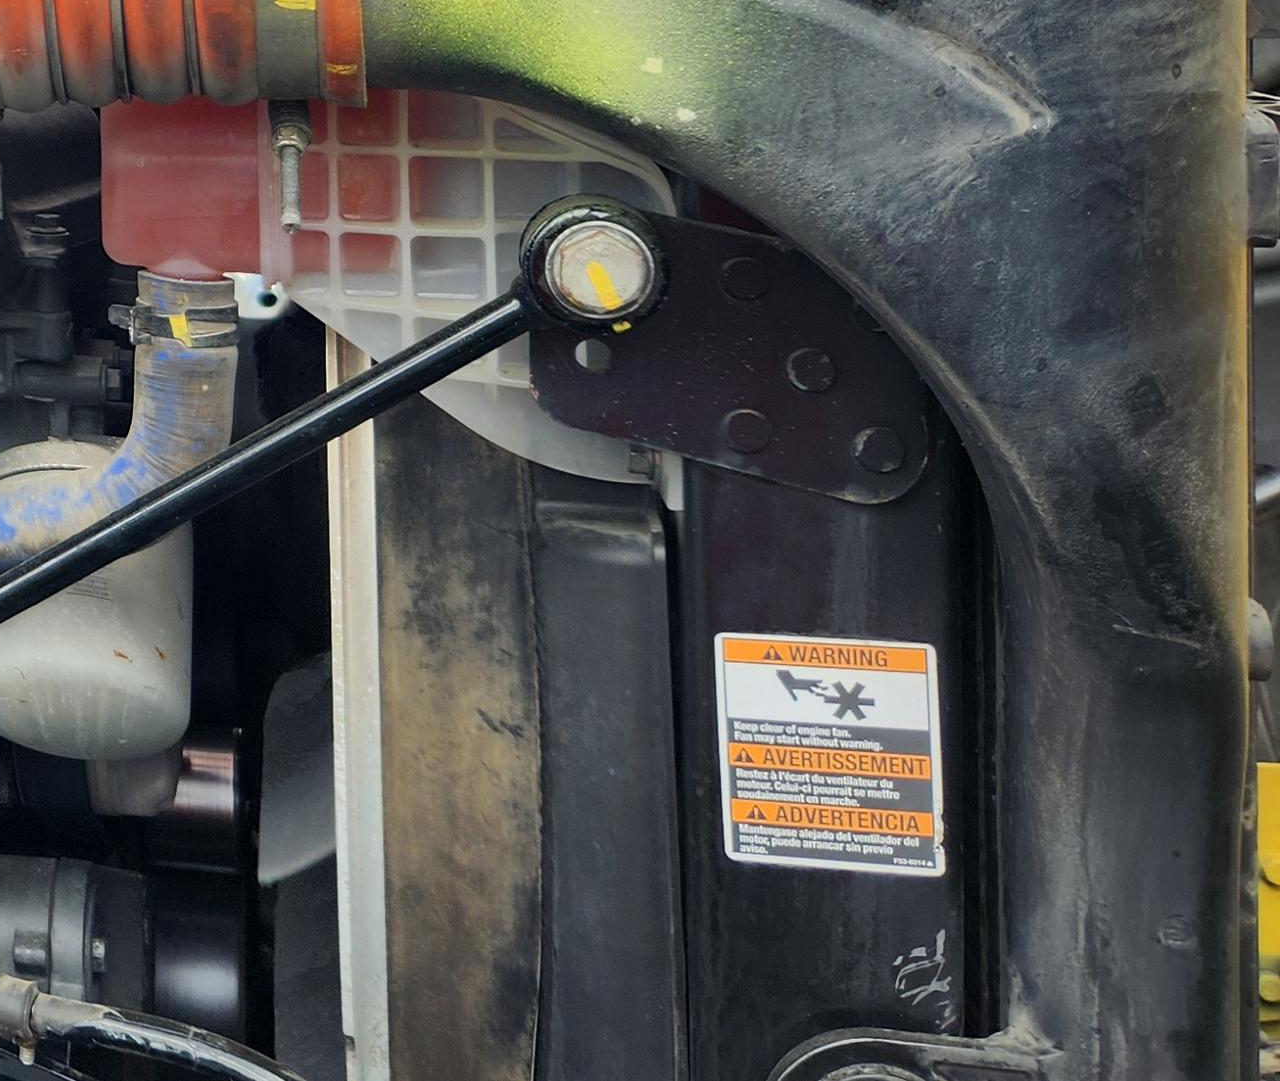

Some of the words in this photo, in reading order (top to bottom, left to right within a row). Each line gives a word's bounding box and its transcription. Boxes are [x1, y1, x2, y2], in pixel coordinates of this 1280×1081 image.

[788, 644, 888, 668] WARNING
[733, 720, 758, 733] Keep
[760, 722, 785, 734] clear
[785, 724, 797, 735] of
[797, 725, 831, 737] engine
[832, 727, 851, 738] fan.
[734, 730, 753, 742] Fan
[754, 733, 776, 745] may
[776, 734, 801, 745] start
[801, 735, 839, 748] without
[839, 739, 883, 752] warning.
[762, 748, 927, 776] AVERTISSEMENT
[735, 767, 769, 780] Restez
[811, 773, 825, 785] du
[825, 775, 878, 788] ventilateur
[879, 778, 894, 789] du
[736, 789, 805, 803] soudainement
[806, 795, 819, 804] en
[820, 796, 860, 807] marche.
[774, 781, 812, 794] Celui-ci
[812, 785, 853, 798] pourrait
[853, 788, 866, 797] se
[867, 789, 900, 800] mettre
[775, 805, 920, 833] ADVERTENCIA
[738, 823, 797, 837] Mantengase
[799, 829, 834, 841] alejado
[835, 831, 852, 841] del
[853, 833, 902, 846] ventilador
[903, 837, 920, 847] del
[739, 834, 770, 846] motor,
[771, 836, 801, 848] puede
[802, 839, 845, 851] arrancar
[845, 842, 861, 853] sin
[862, 844, 894, 855] previo
[740, 844, 768, 855] aviso.
